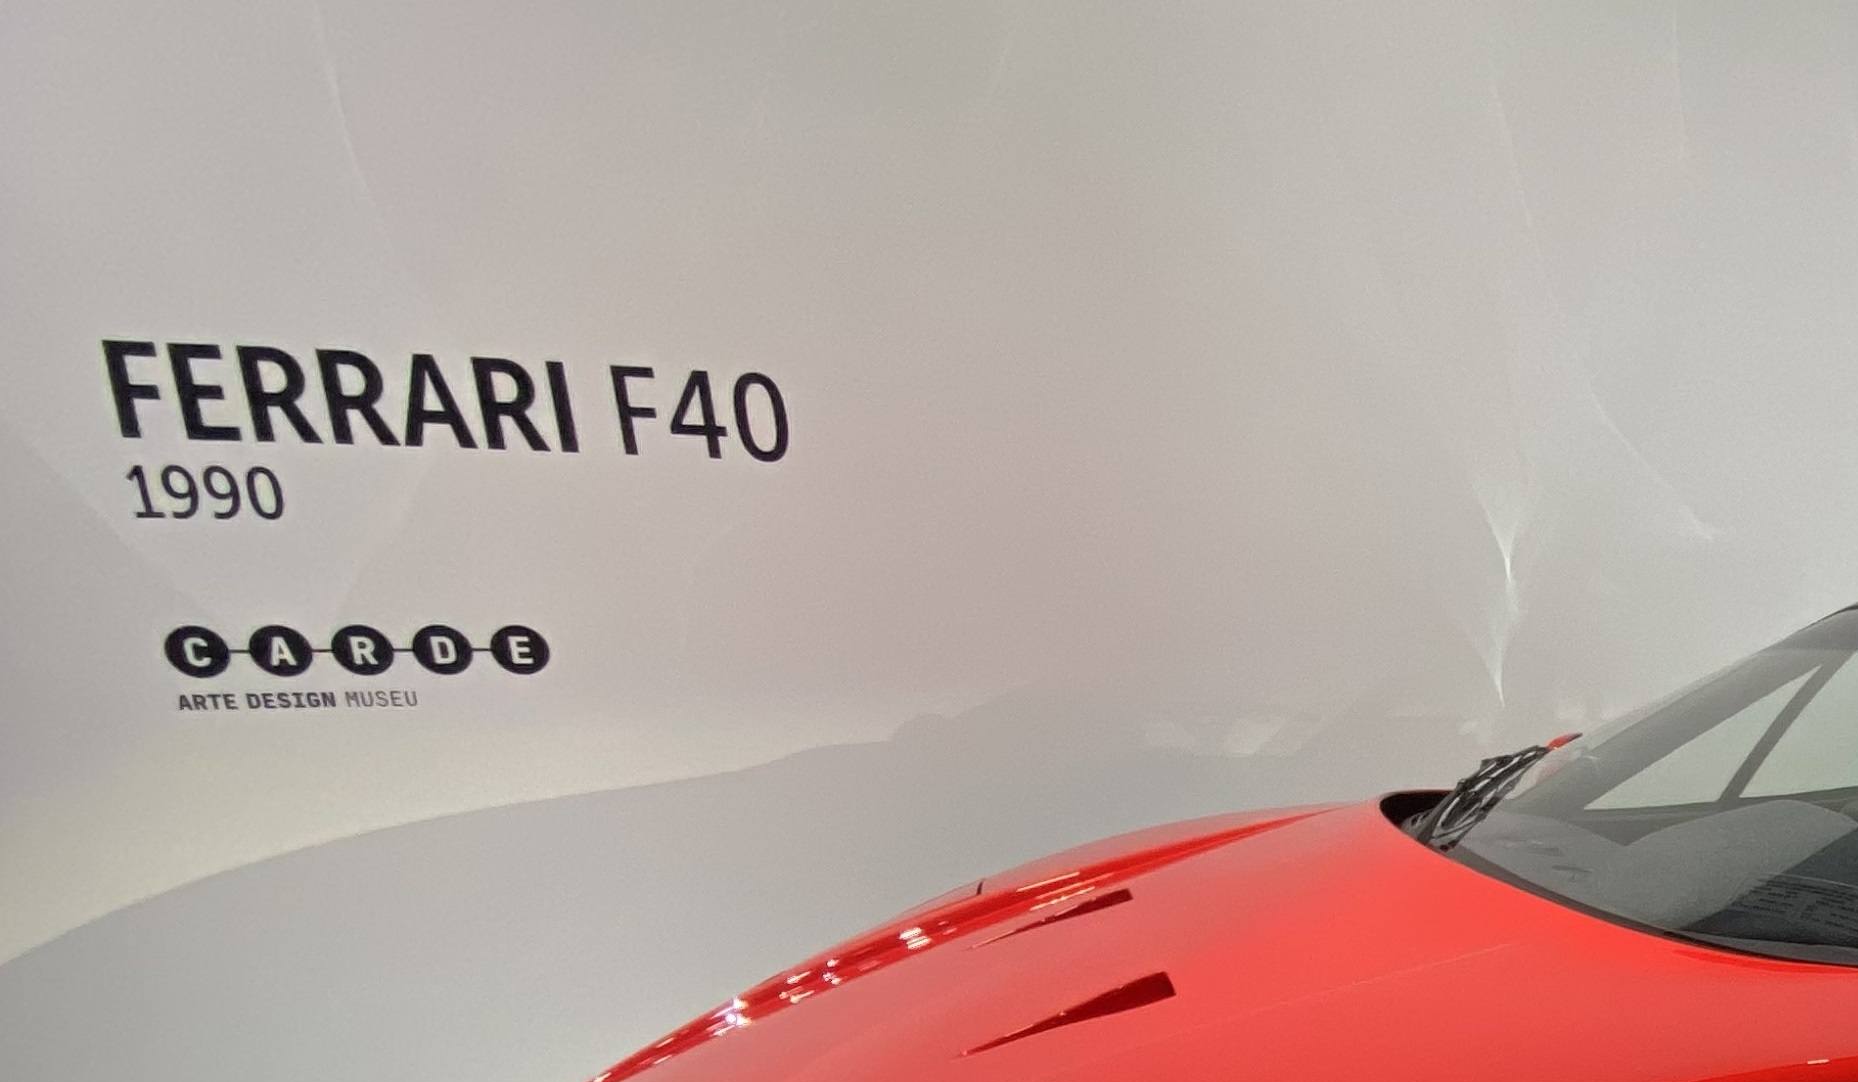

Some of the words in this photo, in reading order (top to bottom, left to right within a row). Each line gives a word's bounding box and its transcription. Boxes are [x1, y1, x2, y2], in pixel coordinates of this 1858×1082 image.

[101, 339, 580, 453] FERRARI
[609, 364, 790, 462] F40
[126, 464, 285, 520] 1990
[181, 633, 537, 669] CARDE
[178, 693, 238, 711] ARTE
[246, 691, 337, 709] DESIGN
[344, 690, 419, 708] MUSEU
